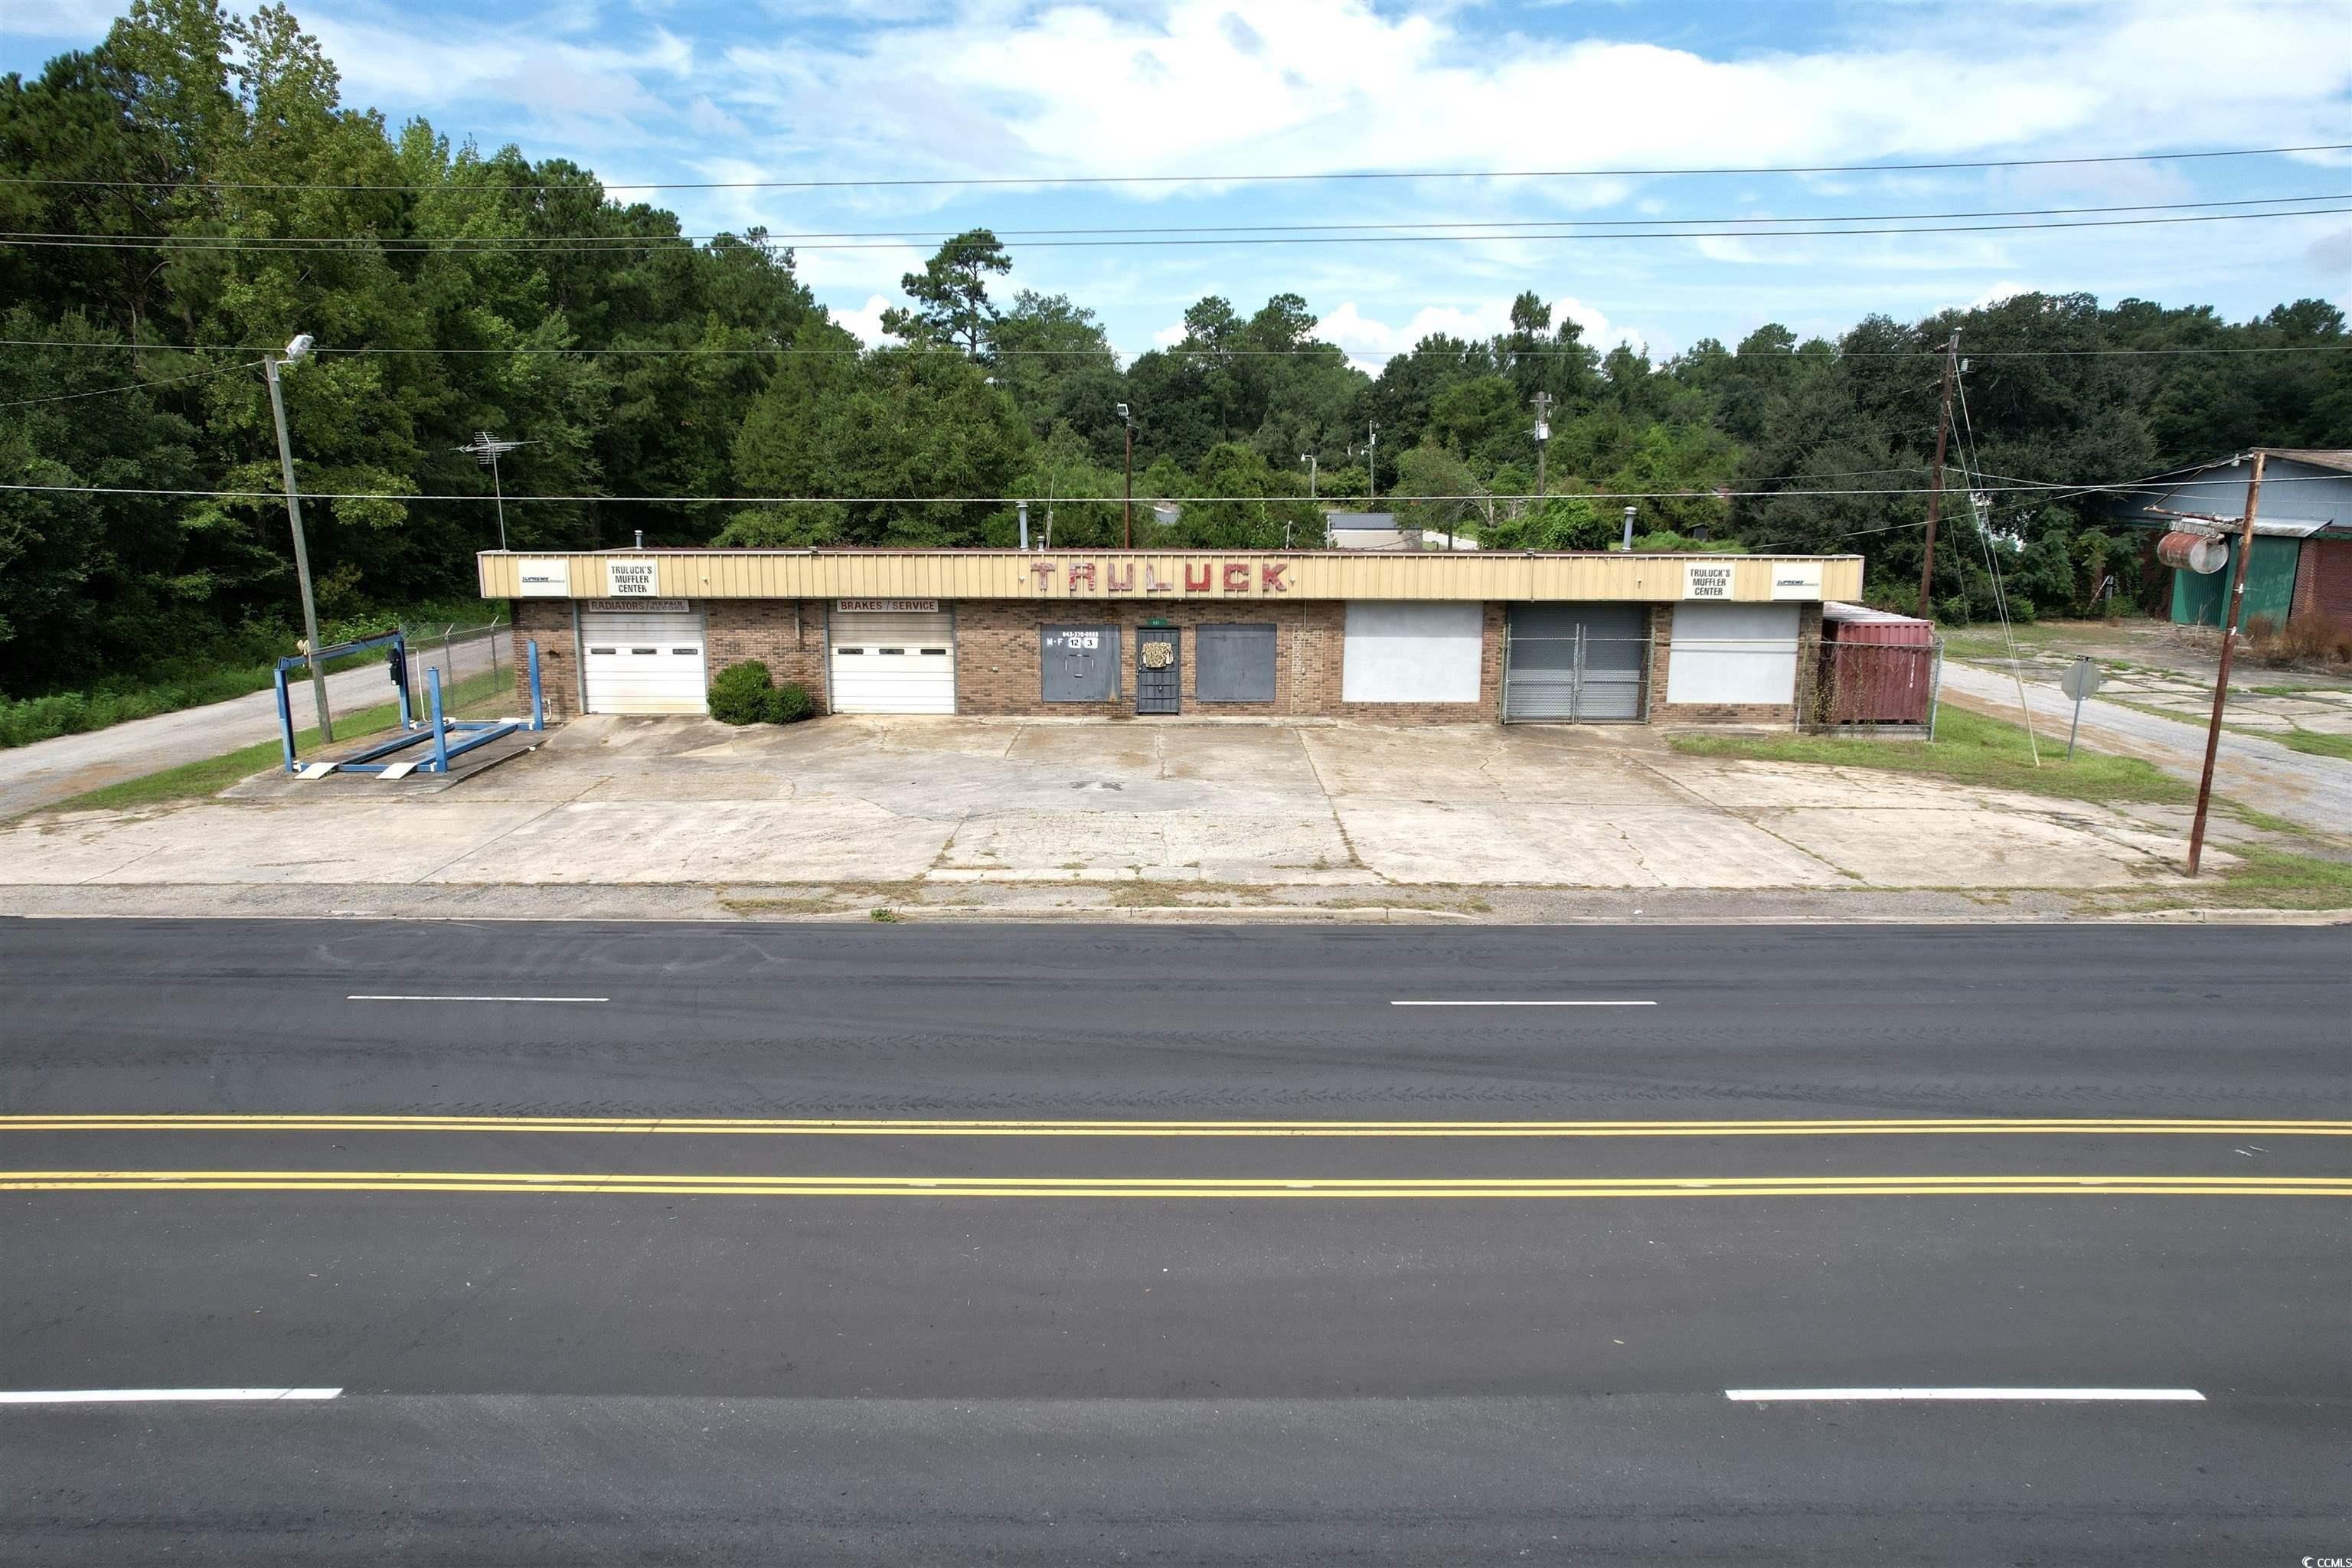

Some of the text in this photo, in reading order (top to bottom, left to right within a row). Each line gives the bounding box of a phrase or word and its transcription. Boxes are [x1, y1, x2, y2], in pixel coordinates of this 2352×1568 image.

[612, 566, 652, 574] TRULUCK'S
[1690, 569, 1730, 577] TRULUCK'S
[615, 575, 649, 583] MUFFLER
[1030, 563, 1288, 590] TRULUCK
[618, 584, 647, 593] CENTER
[1694, 587, 1723, 596] CENTER
[592, 601, 644, 610] RADIATORS
[841, 601, 883, 610] BRAKES
[893, 601, 934, 610] SERVICE
